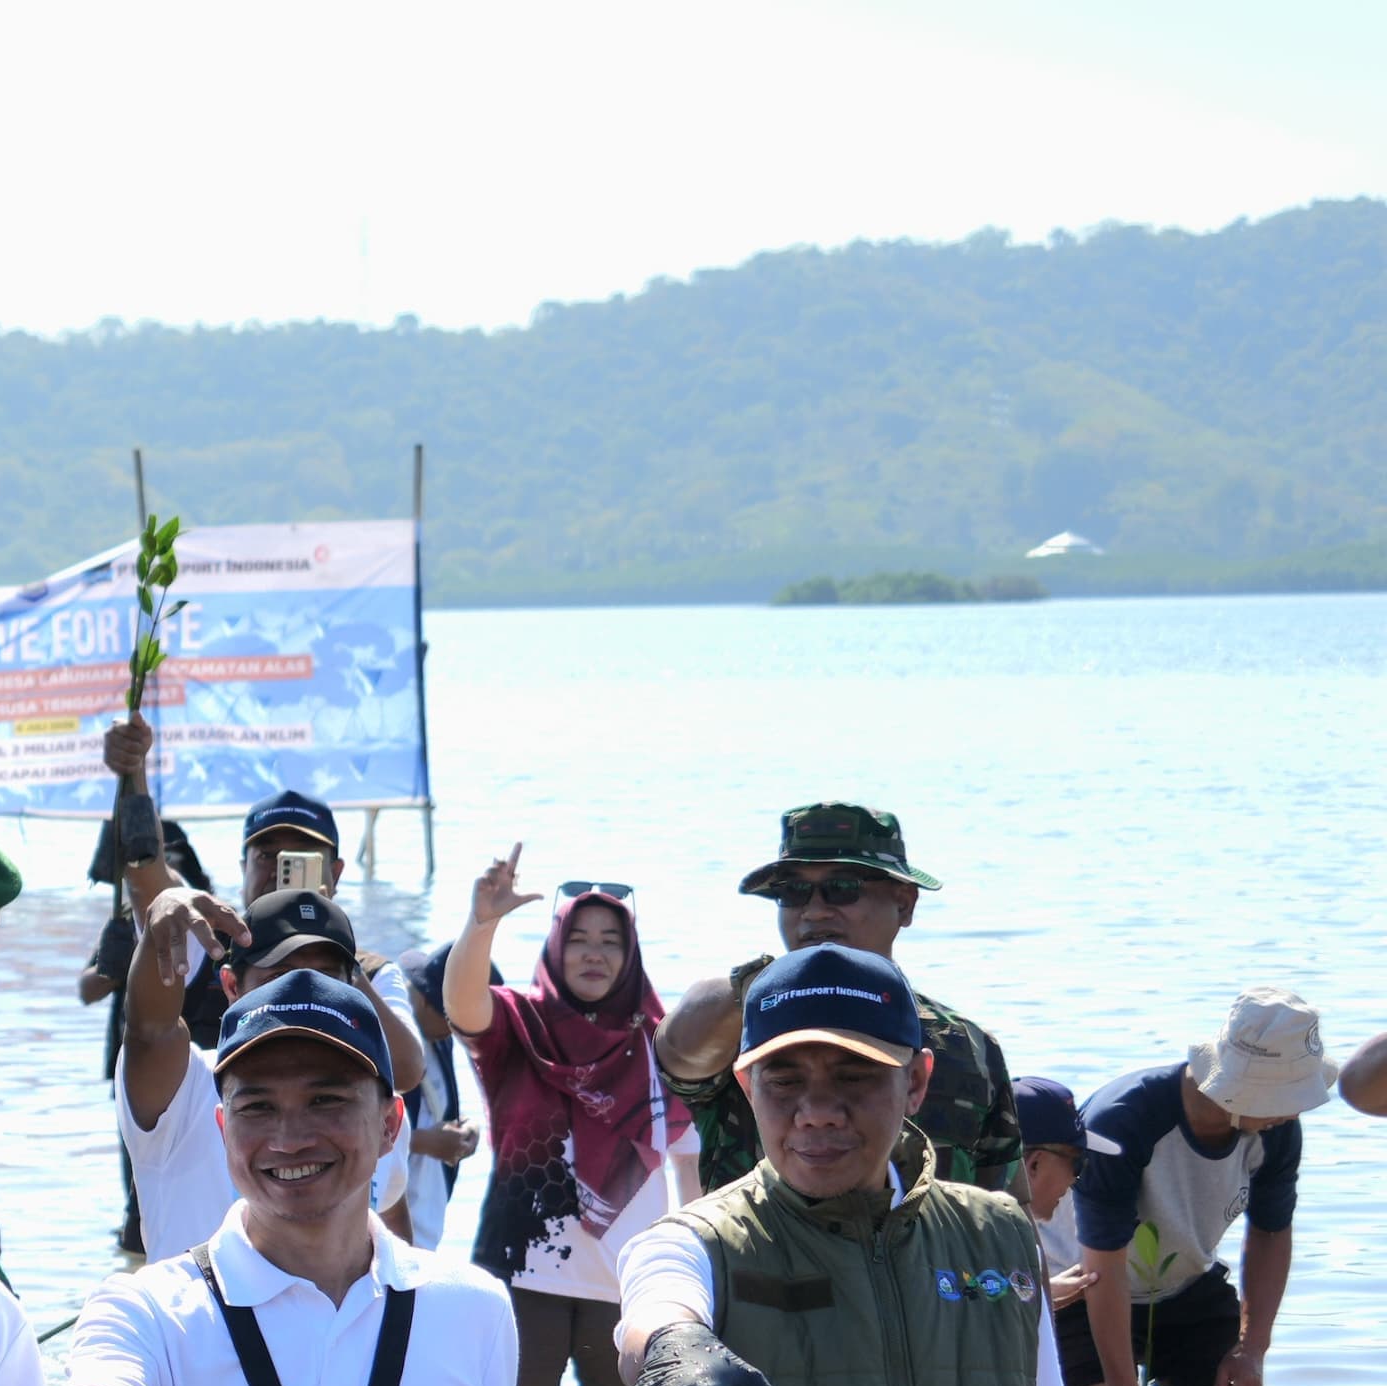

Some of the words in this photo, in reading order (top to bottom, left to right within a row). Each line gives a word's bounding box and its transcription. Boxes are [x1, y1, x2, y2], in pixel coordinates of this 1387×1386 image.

[52, 607, 120, 658] FOR
[778, 991, 790, 1002] PT
[790, 986, 835, 999] FREEPORT
[836, 985, 882, 1003] INDONESIA
[264, 1003, 310, 1014] FREEPORT
[310, 1002, 354, 1027] INDONESIA
